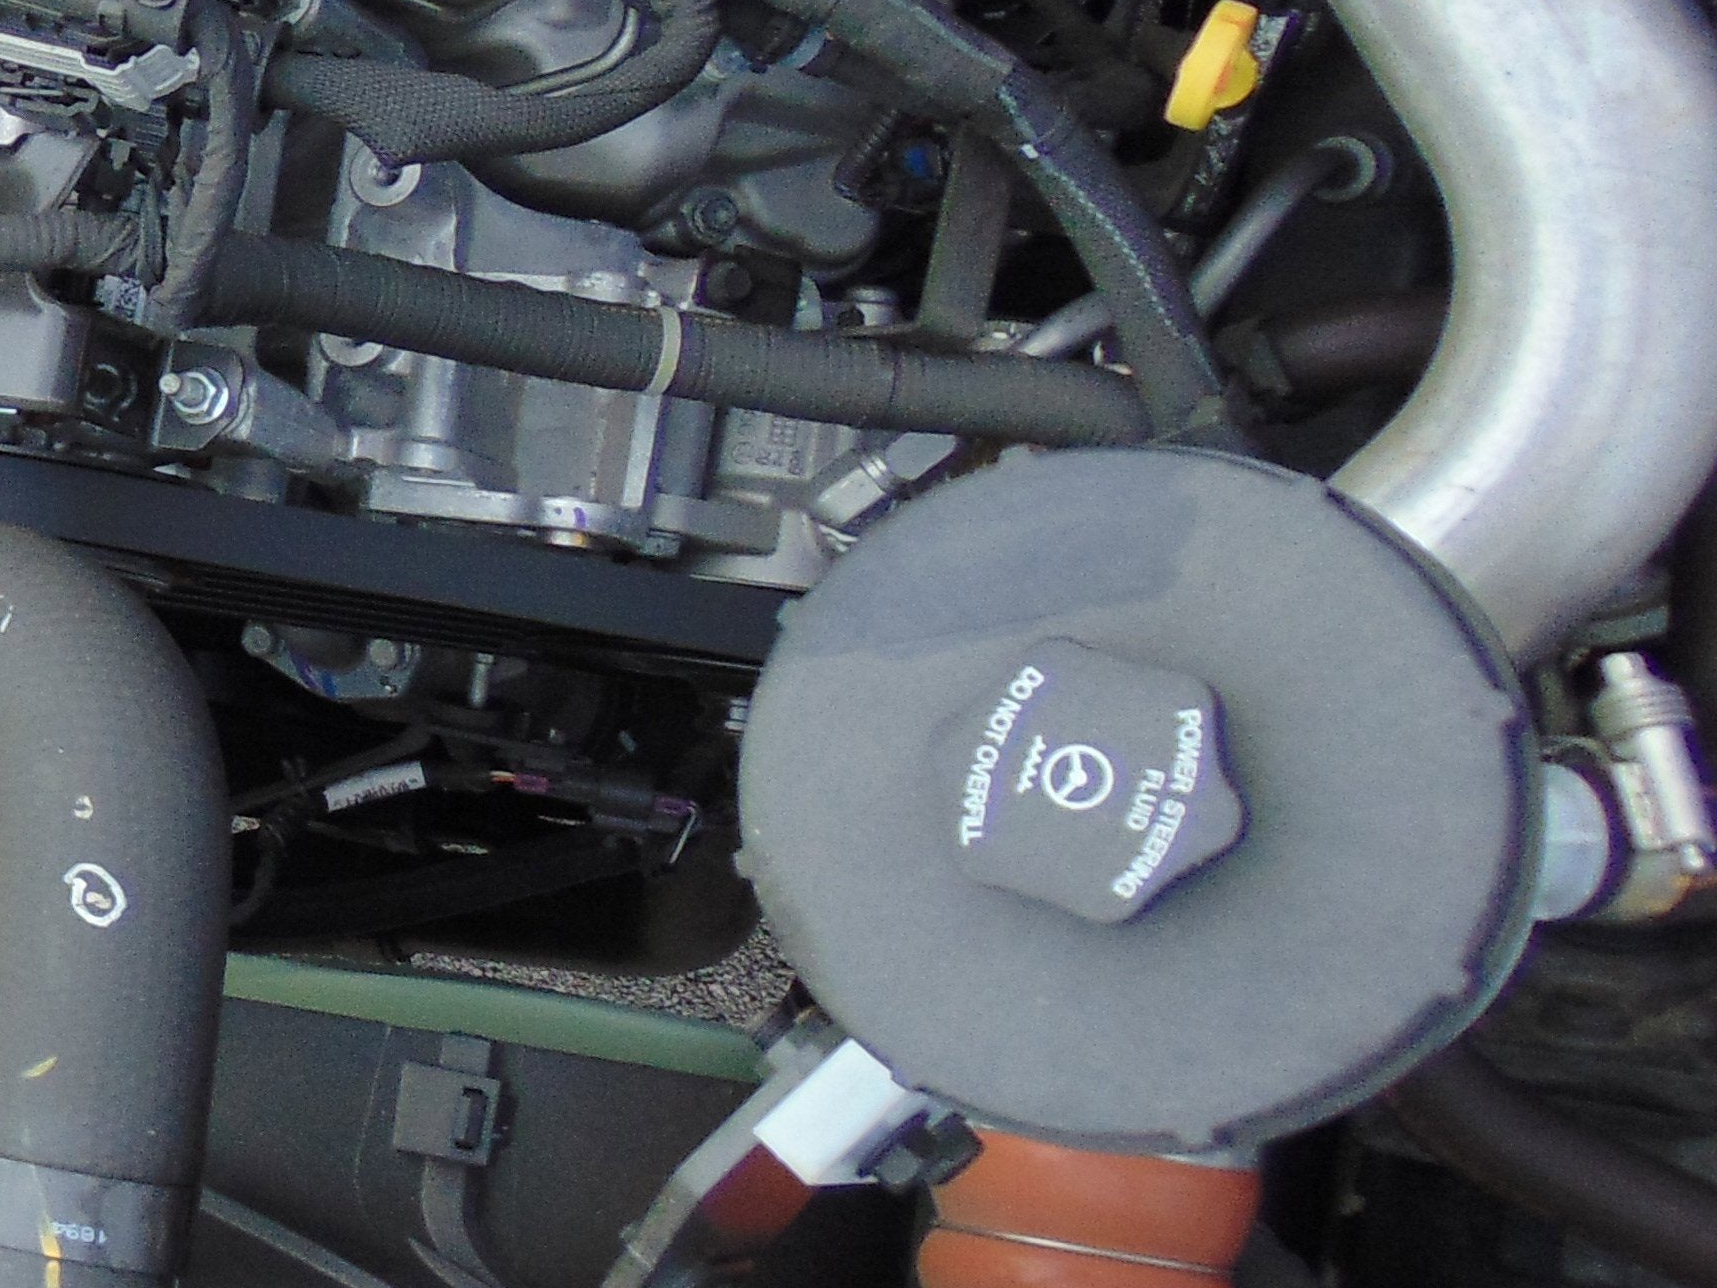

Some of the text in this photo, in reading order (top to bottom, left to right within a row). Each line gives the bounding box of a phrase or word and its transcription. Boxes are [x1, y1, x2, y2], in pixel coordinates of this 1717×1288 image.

[958, 665, 1045, 846] DO NOT OVERFILL
[1110, 710, 1203, 899] POWER STEERING
[1124, 767, 1166, 830] FLUID
